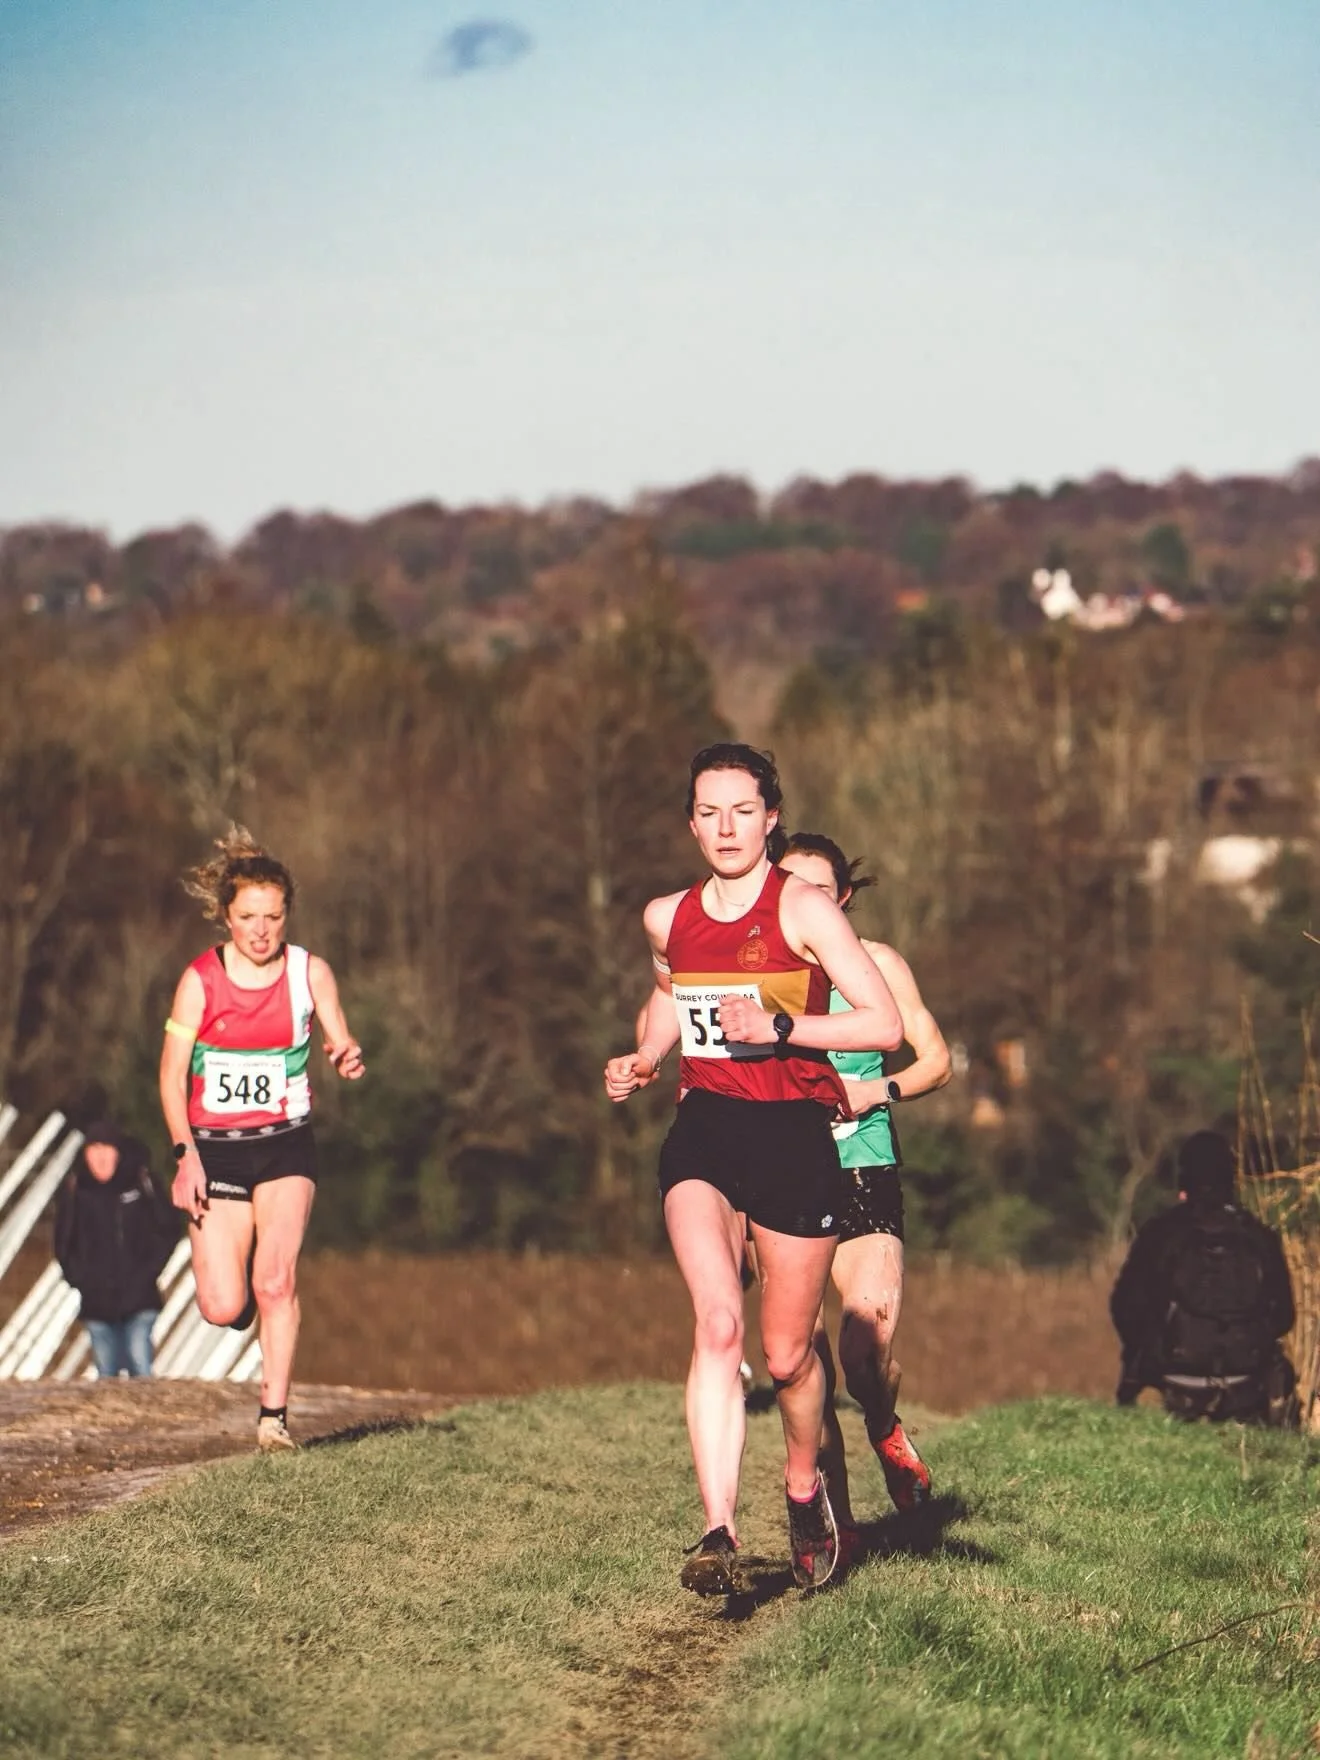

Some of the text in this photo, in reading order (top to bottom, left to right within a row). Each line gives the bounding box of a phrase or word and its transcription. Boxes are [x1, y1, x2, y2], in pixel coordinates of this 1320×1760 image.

[675, 992, 702, 1002] SURREY
[688, 1007, 729, 1047] 55
[216, 1072, 271, 1105] 548
